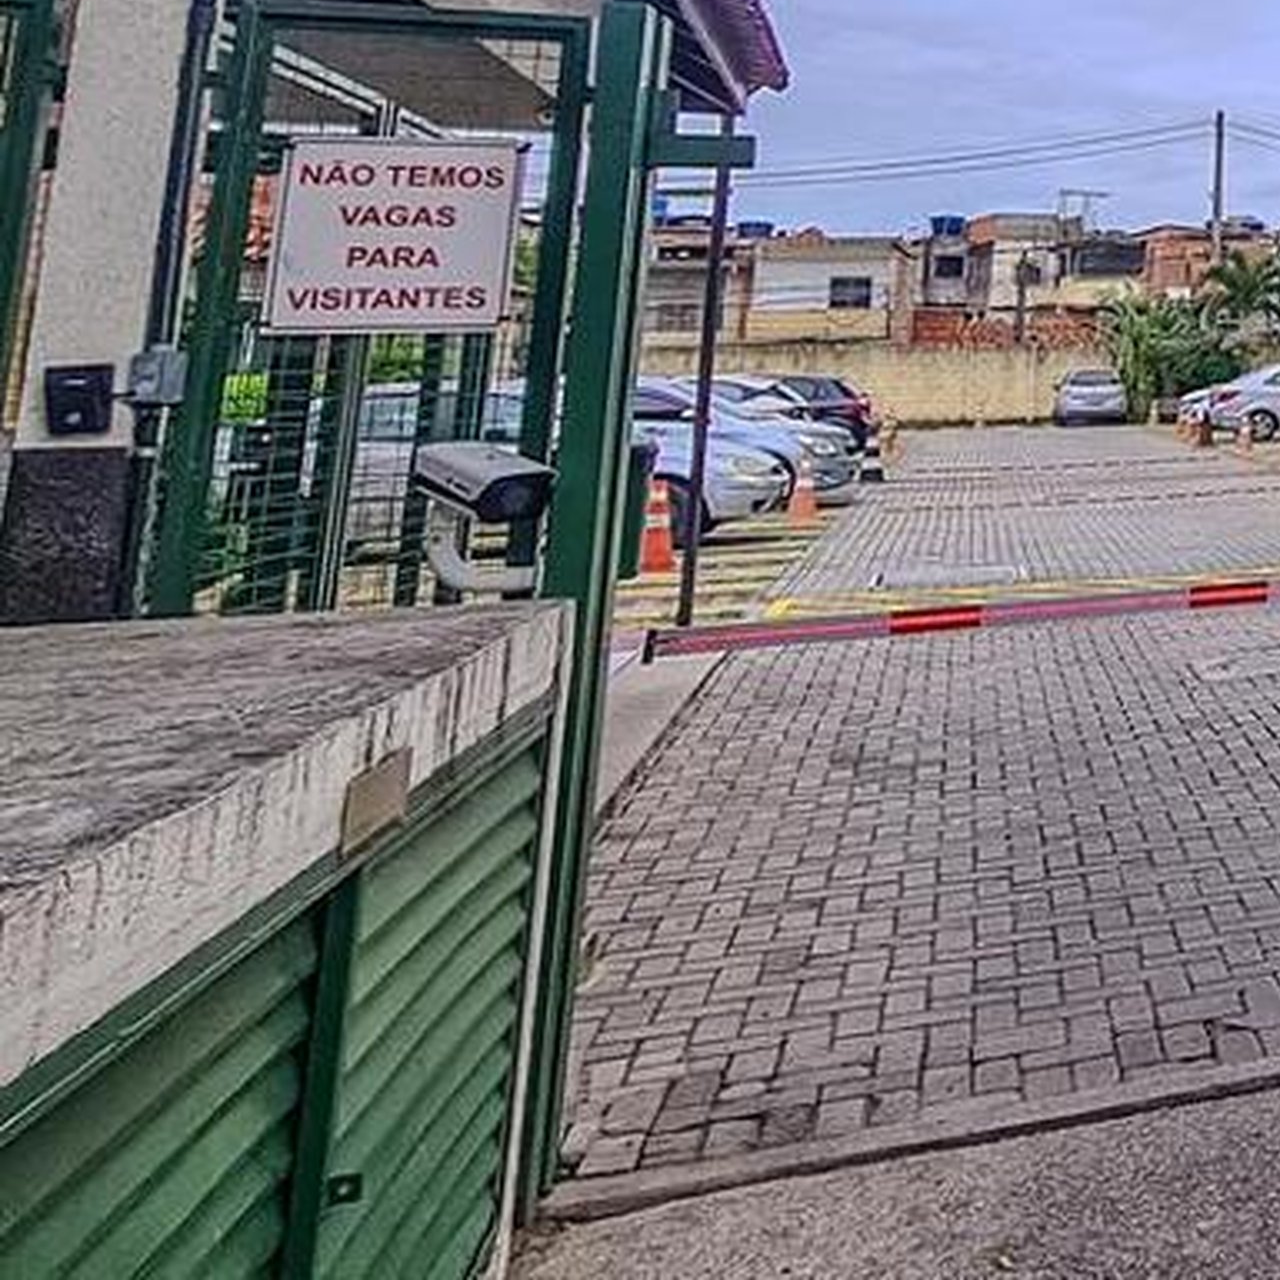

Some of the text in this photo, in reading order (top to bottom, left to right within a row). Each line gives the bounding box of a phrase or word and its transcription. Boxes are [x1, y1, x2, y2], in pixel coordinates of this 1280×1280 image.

[299, 159, 506, 189] NÃO TEMOS
[340, 205, 457, 228] VAGAS
[346, 247, 441, 268] PARA
[287, 285, 488, 311] VISITANTES
